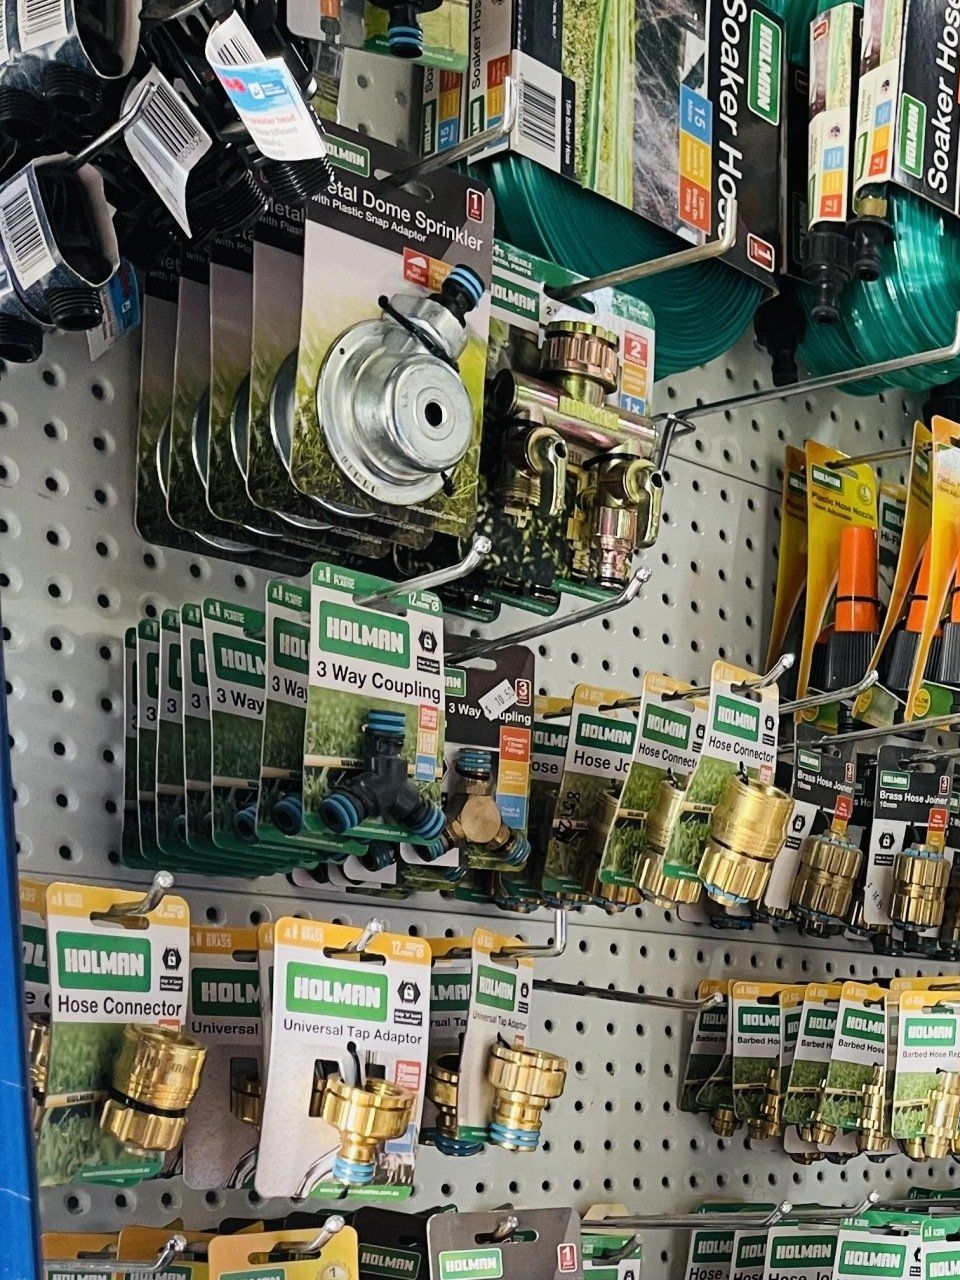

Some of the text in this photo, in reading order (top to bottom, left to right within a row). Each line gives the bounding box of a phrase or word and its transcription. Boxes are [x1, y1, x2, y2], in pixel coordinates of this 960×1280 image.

[472, 0, 481, 89] Soaker Hos
[719, 0, 748, 136] Soaker
[757, 23, 773, 112] HOLMAN
[695, 104, 706, 131] 15
[927, 77, 954, 193] Soaker
[312, 193, 427, 242] with Plastic Snap Adaptor
[327, 180, 483, 252] etal Dome Sprinkler
[630, 342, 641, 357] 2
[326, 616, 404, 654] HOLMAN
[221, 647, 266, 675] HOLM
[317, 661, 441, 704] 3 Way Coupling
[518, 681, 528, 696] 3
[216, 688, 265, 714] 3 Way
[647, 714, 687, 740] HOLMAN
[717, 705, 757, 732] HOLMAN
[581, 723, 632, 745] HOLMAN
[574, 750, 611, 770] Hose
[708, 736, 774, 764] Hose Connector
[798, 770, 853, 793] Brass Hose Joiner
[880, 790, 948, 804] Brass Hose Joiner
[64, 947, 144, 977] HOLMAN
[294, 976, 381, 1008] HOLMAN
[58, 995, 182, 1016] Hose Connector
[191, 1021, 259, 1035] Universal
[283, 1018, 422, 1045] Universal Tap Adaptor
[908, 1026, 953, 1039] HOLMAN
[902, 1051, 927, 1059] Barbed
[929, 1051, 947, 1059] Hose
[562, 1246, 571, 1261] 1
[776, 1243, 832, 1259] HOLMAN
[844, 1250, 900, 1269] HOLMAN
[445, 1256, 497, 1273] HOLMAN
